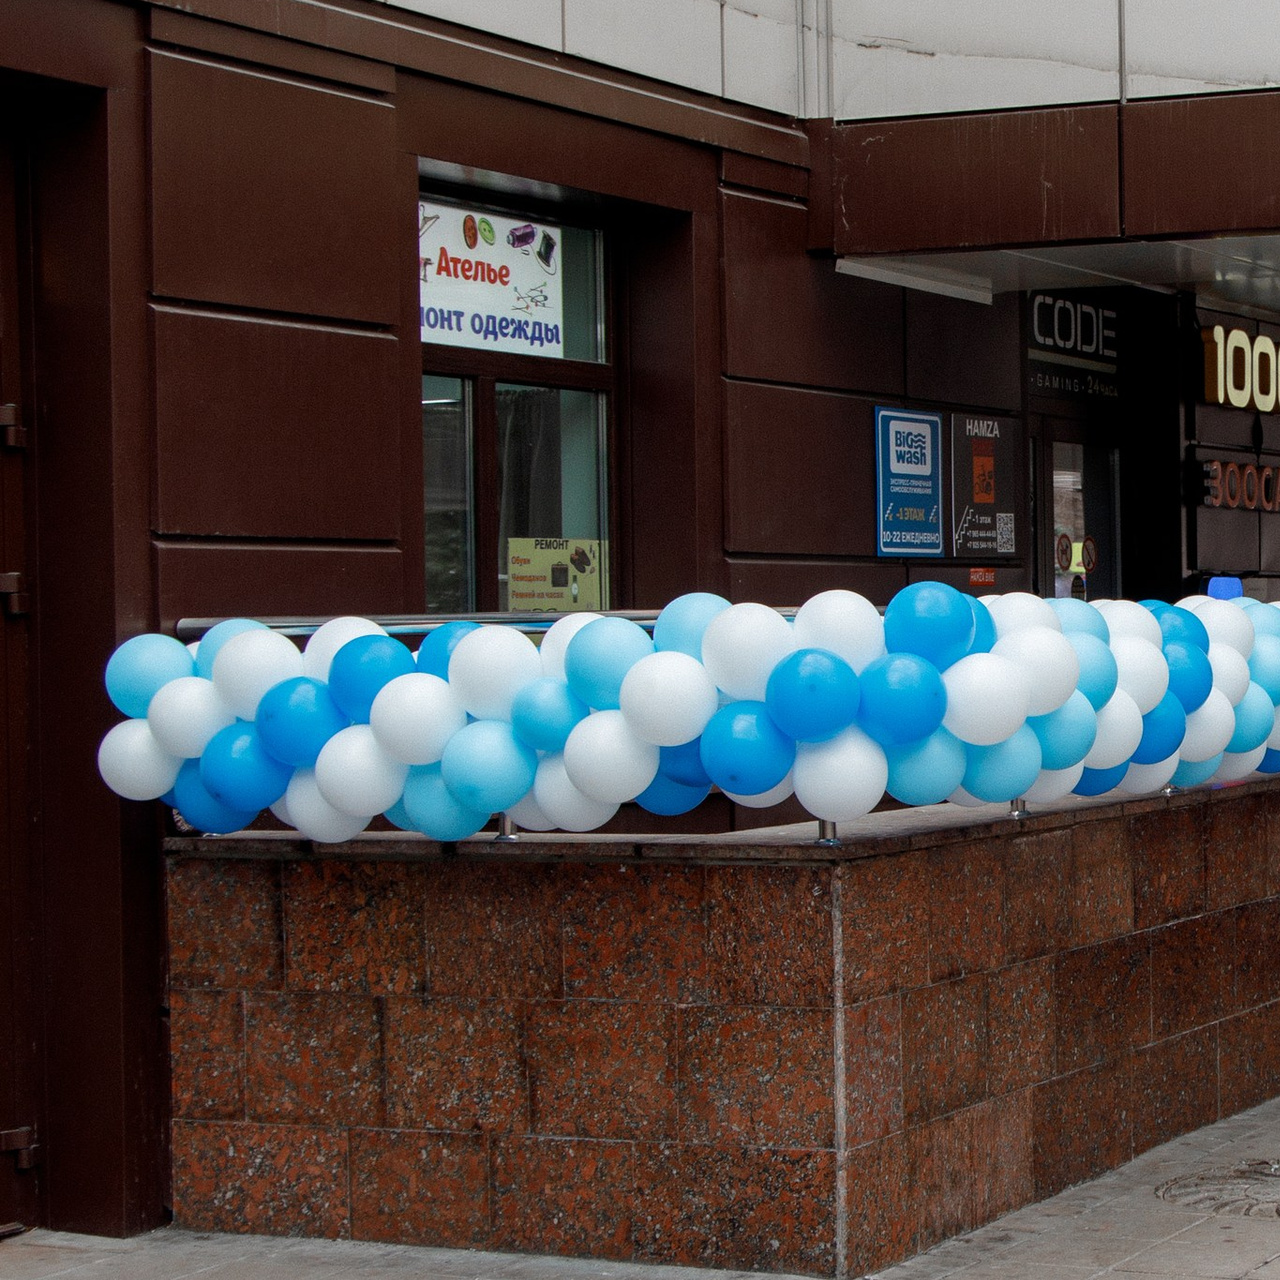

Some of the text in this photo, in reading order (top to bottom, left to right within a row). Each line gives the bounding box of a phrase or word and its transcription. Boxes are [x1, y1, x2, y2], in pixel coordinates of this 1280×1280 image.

[436, 246, 511, 287] Ателье
[470, 313, 562, 348] одежды
[1033, 294, 1118, 358] CODE
[1036, 373, 1080, 393] GAMING
[966, 419, 1000, 438] HAMZA
[895, 446, 927, 466] wash
[903, 507, 926, 521] ЭТАЖ
[534, 539, 570, 551] РЕМОНТ
[883, 531, 940, 545] 10-22 ЕЖЕДНЕВНО
